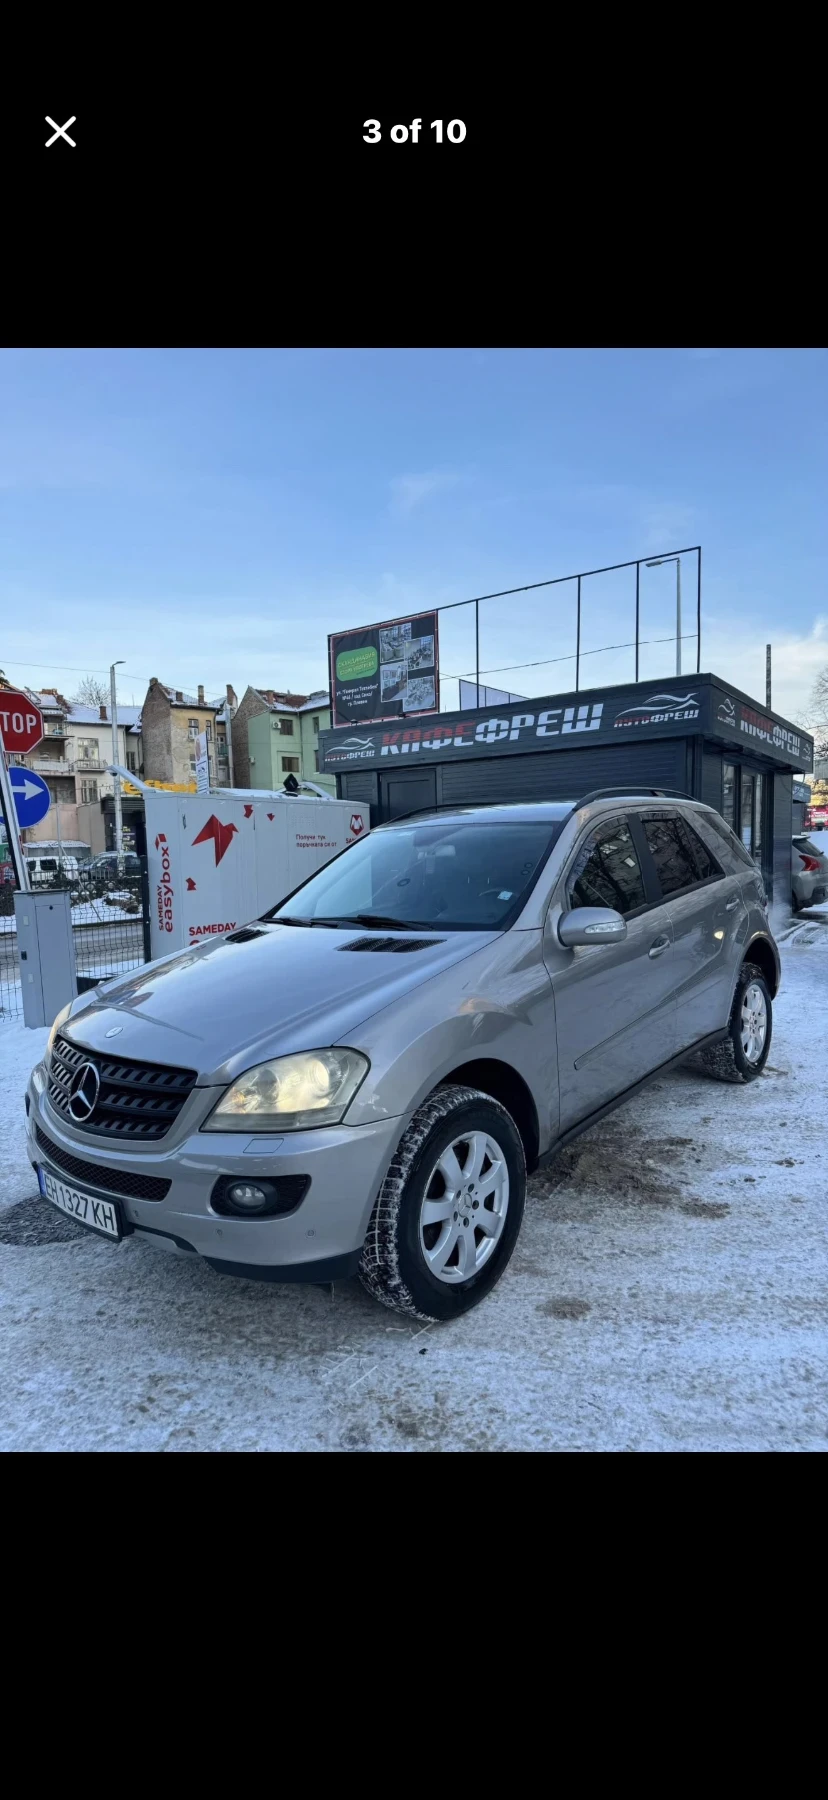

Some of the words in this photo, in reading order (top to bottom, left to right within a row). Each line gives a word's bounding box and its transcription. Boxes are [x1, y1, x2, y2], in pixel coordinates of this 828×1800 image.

[0, 711, 37, 734] TOP
[295, 833, 316, 841] Получи
[160, 846, 174, 933] easybox
[189, 922, 237, 936] SAMEDAY
[60, 1186, 88, 1219] 1327
[91, 1200, 115, 1231] KH
